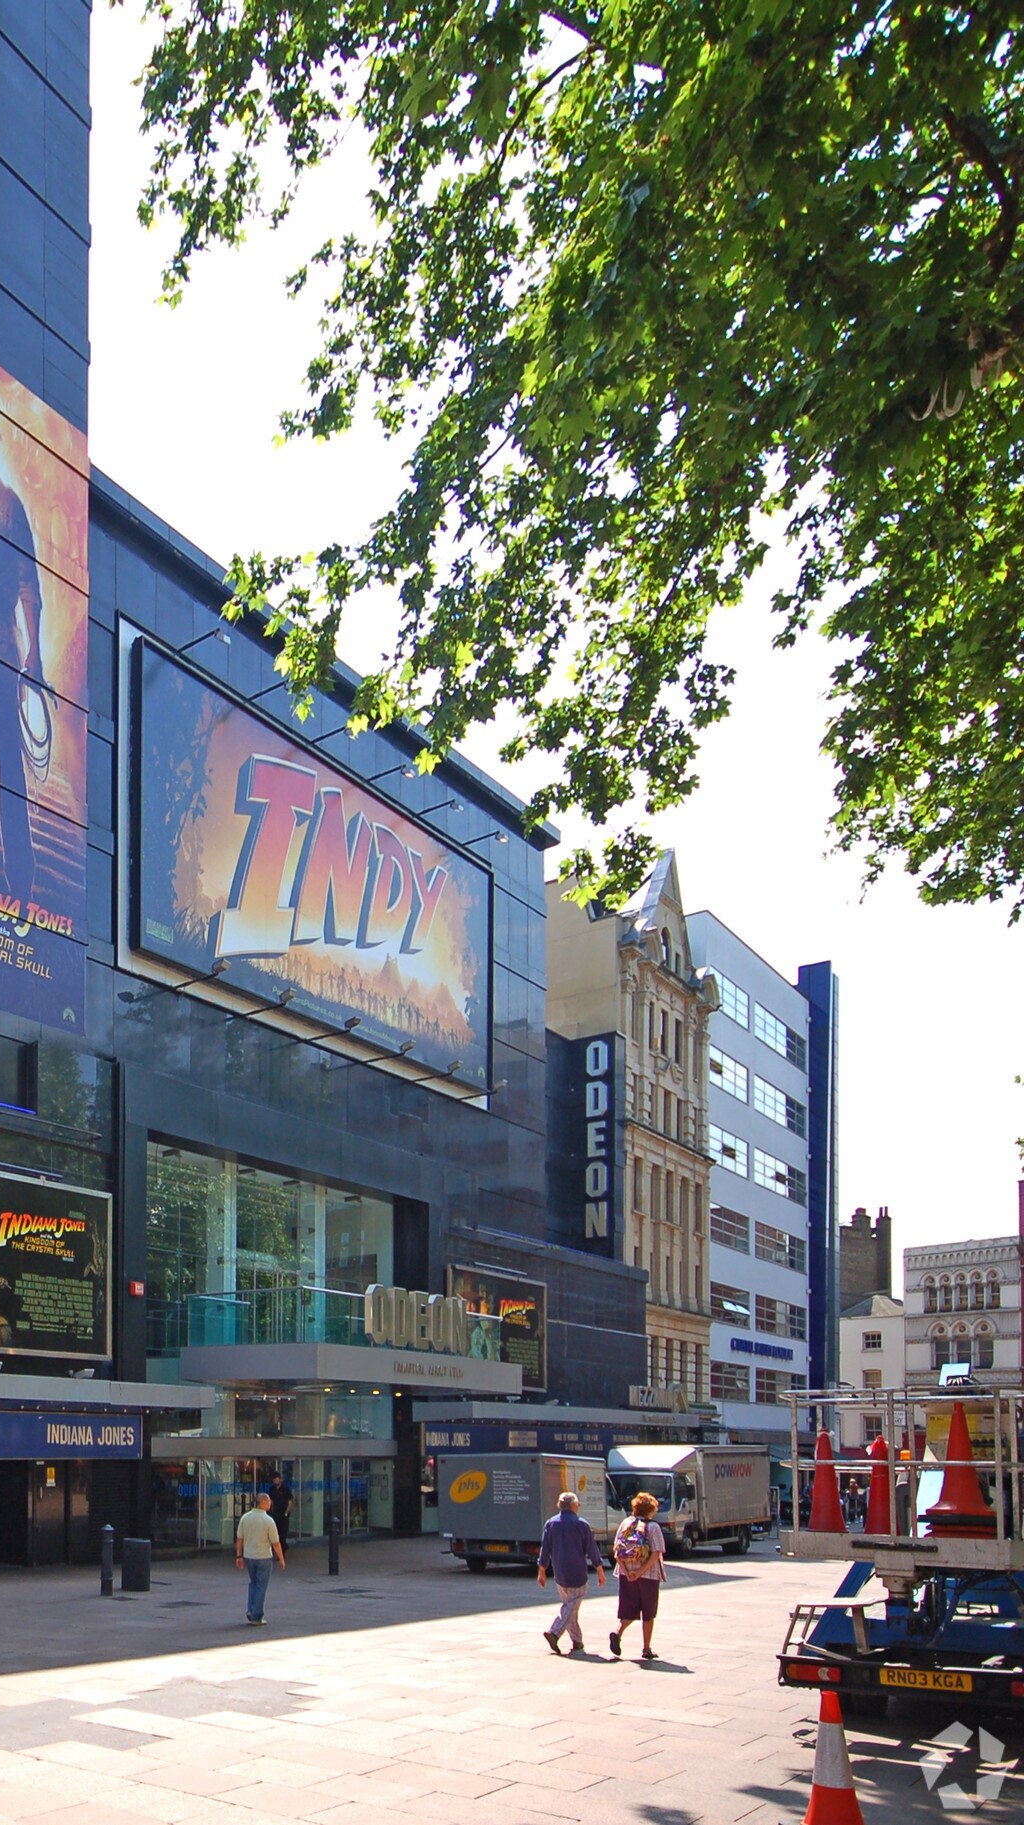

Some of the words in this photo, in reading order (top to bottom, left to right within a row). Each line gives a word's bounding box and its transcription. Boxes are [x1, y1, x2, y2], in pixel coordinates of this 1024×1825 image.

[215, 754, 447, 957] INDY
[13, 901, 74, 938] JONES
[18, 942, 34, 957] OF
[585, 1040, 608, 1239] ODEON
[54, 1217, 86, 1239] JONES
[12, 1241, 25, 1251] THE
[26, 1244, 54, 1255] CRYSTAL
[24, 1236, 55, 1247] KINGDOM
[56, 1240, 65, 1248] OF
[364, 1283, 468, 1356] ODEON
[47, 1423, 93, 1446] INDIANA
[97, 1426, 134, 1446] JONES
[426, 1431, 450, 1447] INDIANA
[451, 1432, 470, 1447] JONES
[715, 1463, 752, 1481] powwow
[178, 1483, 199, 1497] ODEO
[458, 1478, 480, 1493] phs
[886, 1671, 928, 1687] RN03
[932, 1673, 965, 1689] KGA
